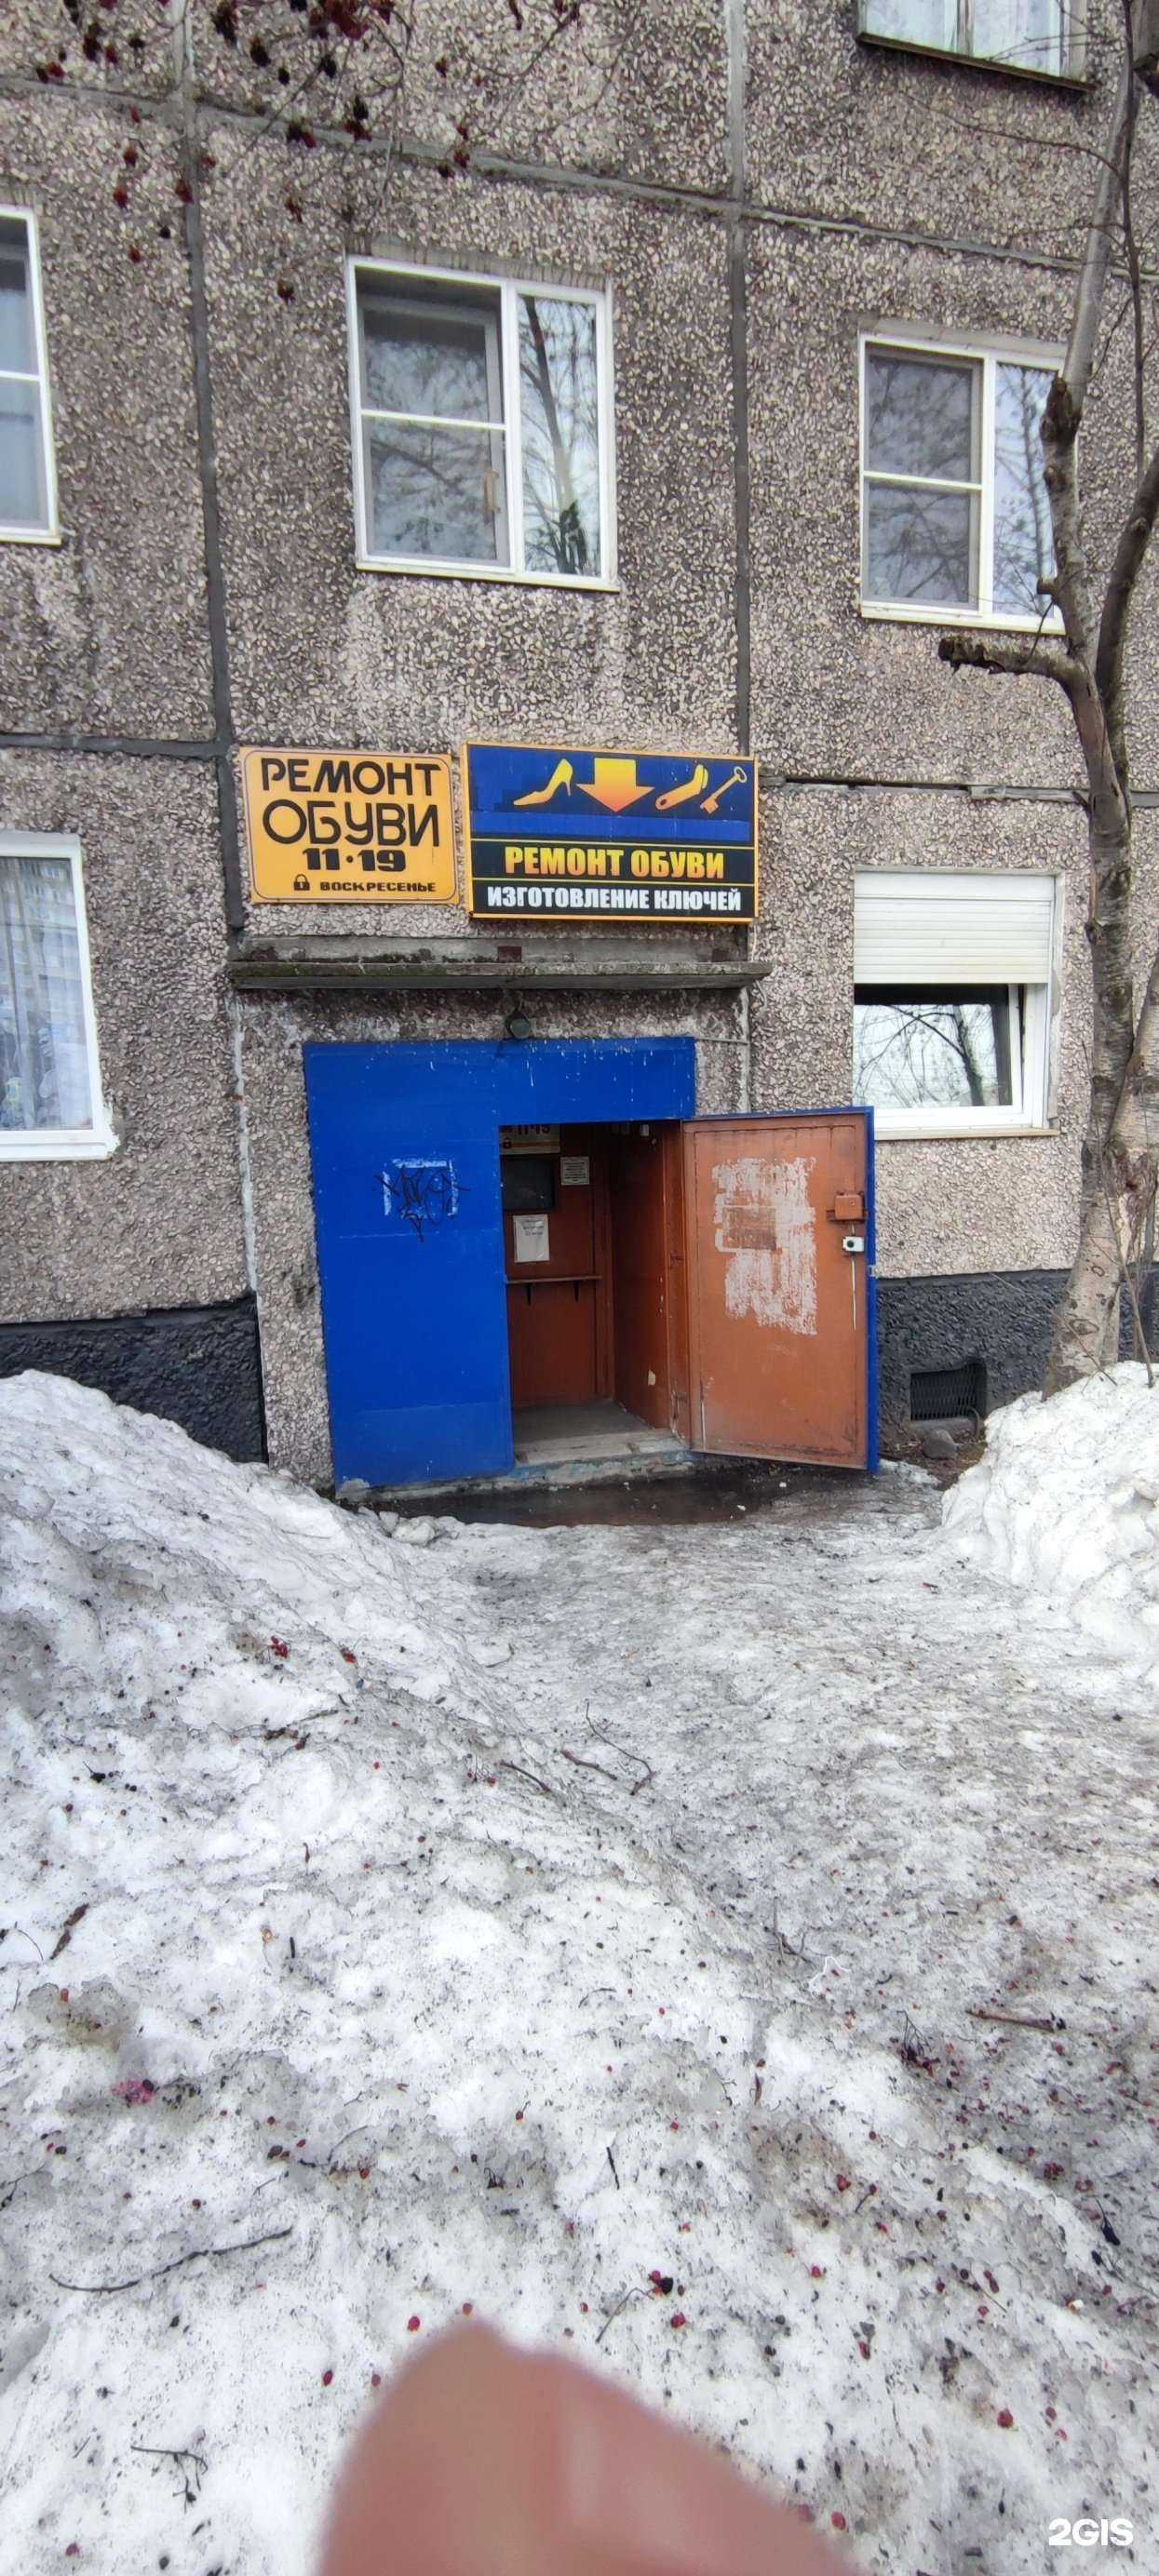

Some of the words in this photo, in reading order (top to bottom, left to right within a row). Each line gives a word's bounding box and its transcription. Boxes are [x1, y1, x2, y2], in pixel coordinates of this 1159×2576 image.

[261, 758, 441, 797] РЕМОНТ
[263, 798, 440, 847] ОБУВИ
[505, 846, 625, 877] РЕМОНТ
[630, 850, 724, 879] ОБУВИ
[319, 880, 437, 892] ВОСКРЕСЕНЬЕ
[487, 886, 650, 909] ИЗГОТОВЛЕНИЕ
[654, 887, 742, 911] КЛЮЧЕЙ
